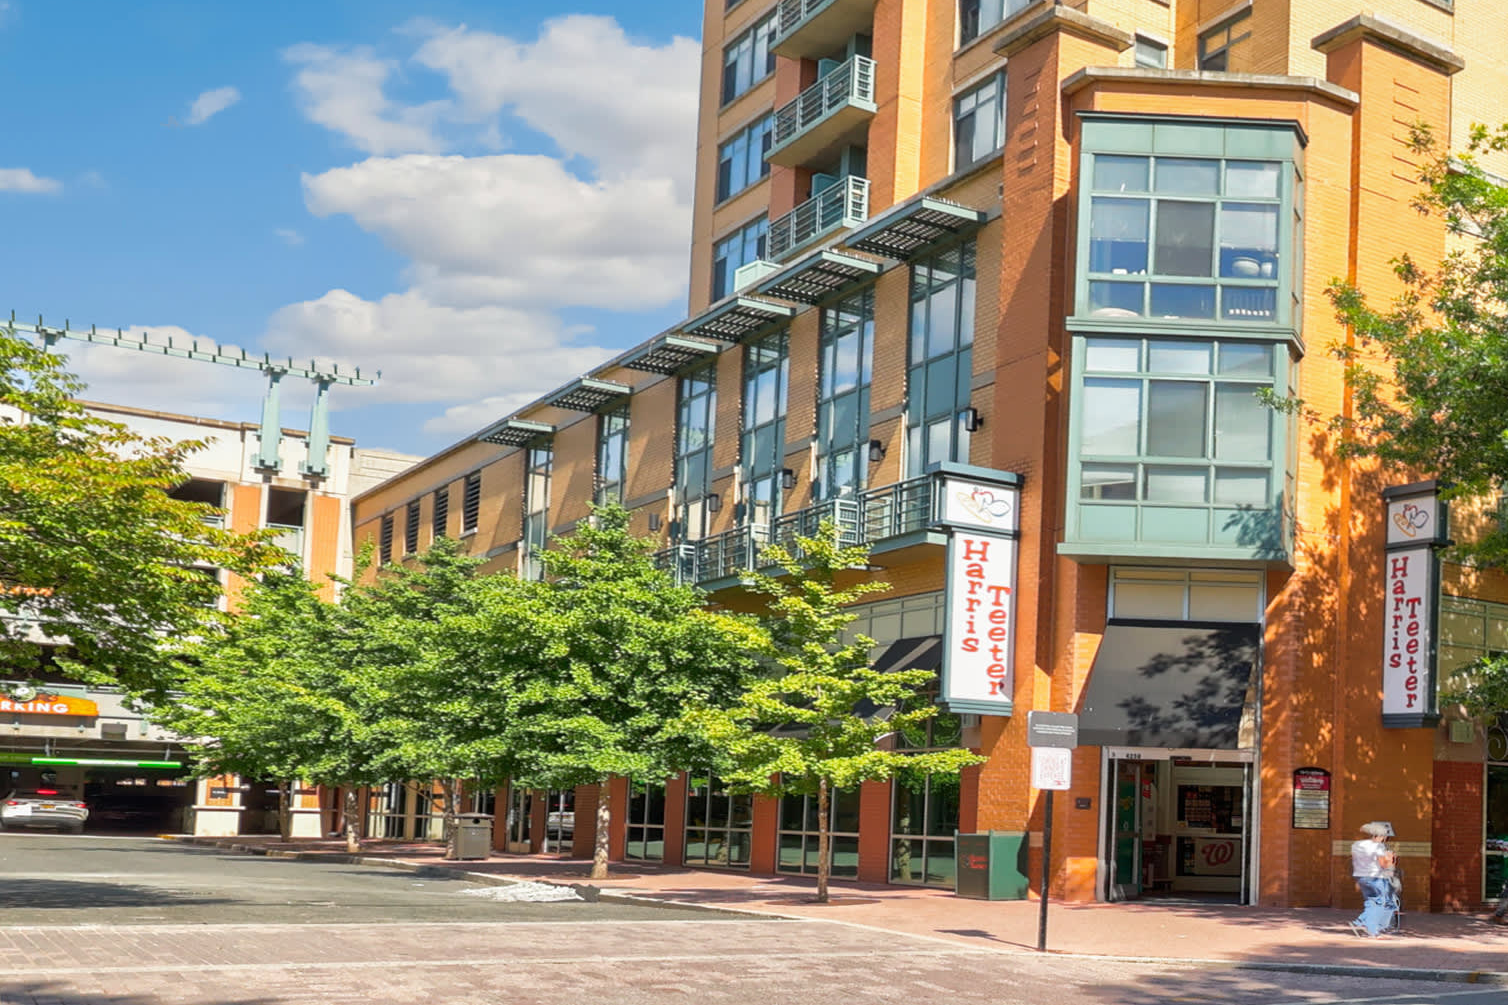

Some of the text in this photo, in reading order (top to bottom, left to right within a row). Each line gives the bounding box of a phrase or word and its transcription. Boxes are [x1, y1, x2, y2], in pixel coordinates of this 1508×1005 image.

[962, 539, 990, 652] Harris
[986, 585, 1012, 695] Teeter
[1389, 556, 1409, 668] Harris
[1405, 597, 1421, 708] Teeter
